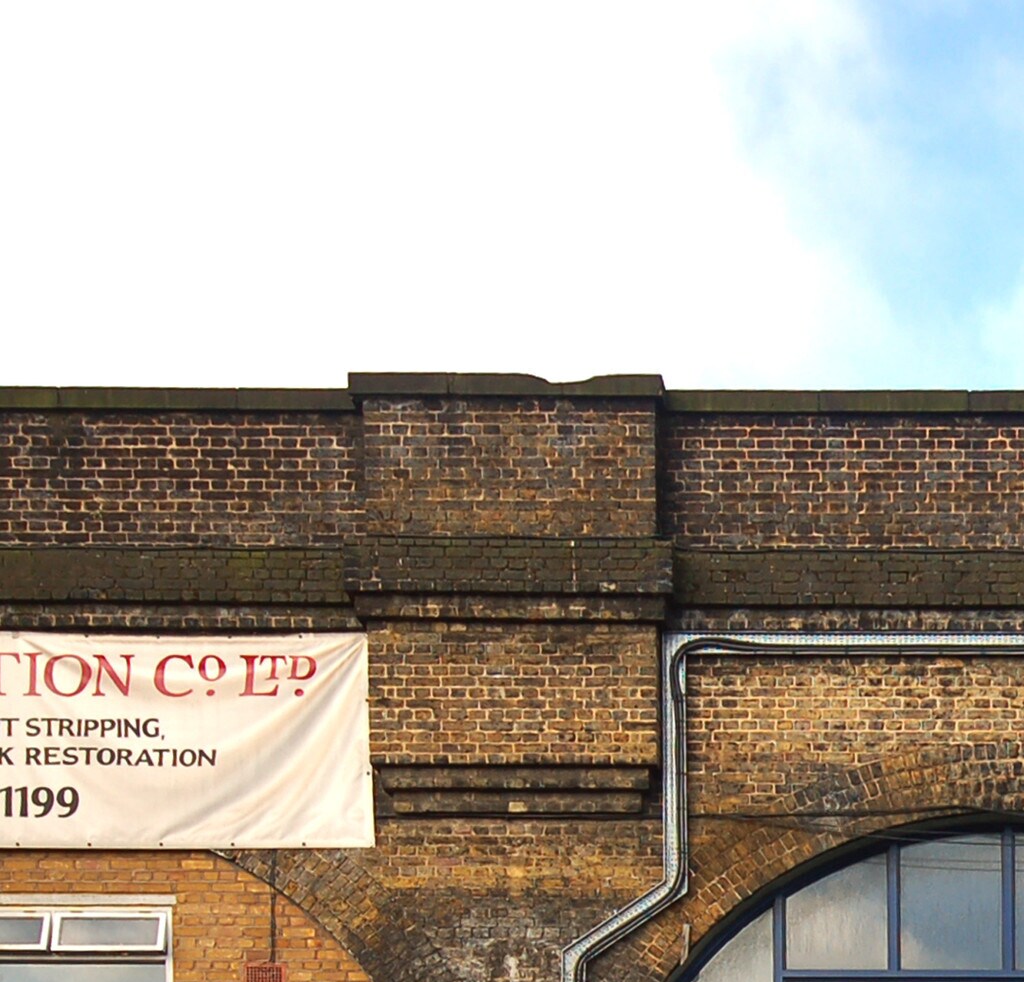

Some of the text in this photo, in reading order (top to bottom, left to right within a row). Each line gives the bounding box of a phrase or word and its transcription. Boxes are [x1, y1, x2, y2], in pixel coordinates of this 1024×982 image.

[25, 717, 166, 741] STRIPPING,
[25, 746, 217, 767] RESTORATION
[0, 785, 80, 818] 1199
